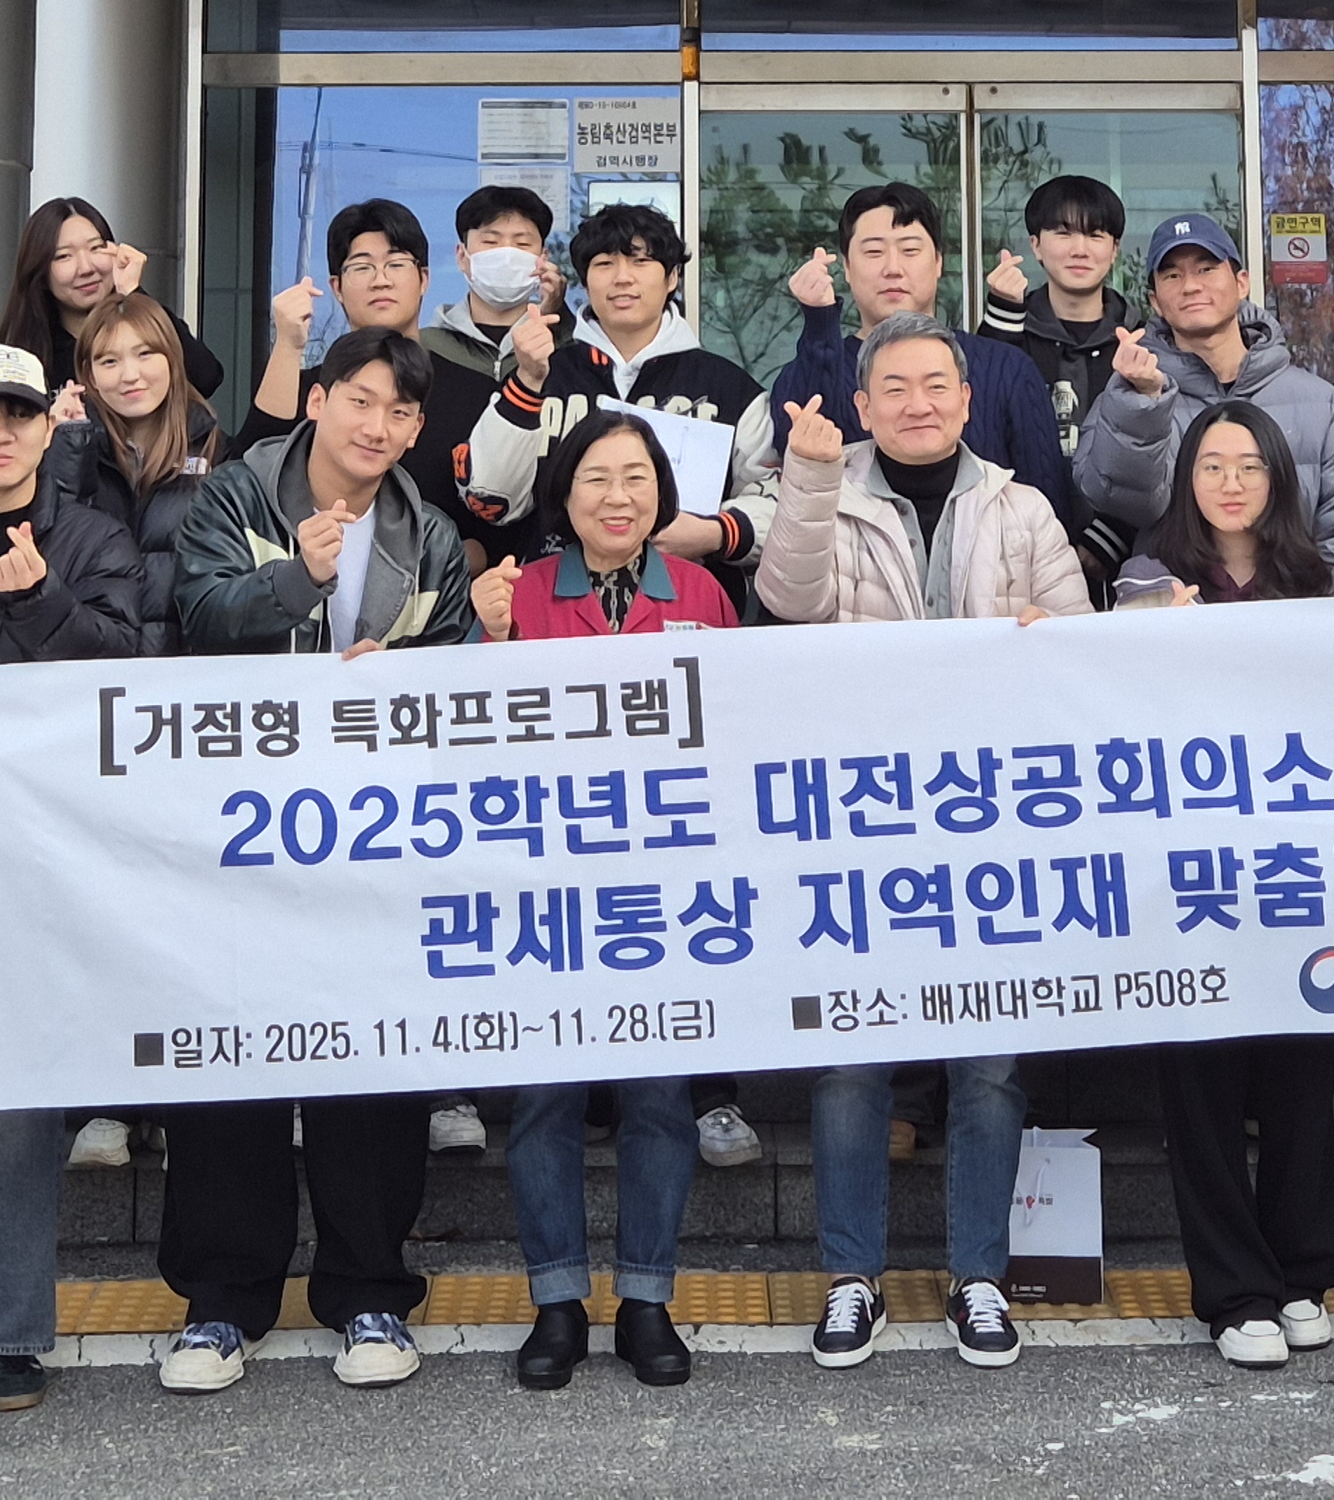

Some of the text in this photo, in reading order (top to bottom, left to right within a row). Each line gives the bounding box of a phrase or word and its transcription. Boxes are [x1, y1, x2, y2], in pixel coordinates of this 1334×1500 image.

[577, 122, 677, 146] 농림축산검역본부
[1275, 216, 1321, 230] 금연구역
[99, 656, 705, 777] [거점형 특화프로그램]
[219, 766, 718, 868] 2025학년도
[420, 875, 760, 979] 관세통상
[797, 851, 1131, 955] 지역인재
[920, 973, 1104, 1026] 배재대학교
[1114, 963, 1230, 1012] P508호
[265, 1020, 360, 1064] 2025.
[606, 998, 716, 1044] 28.(금)
